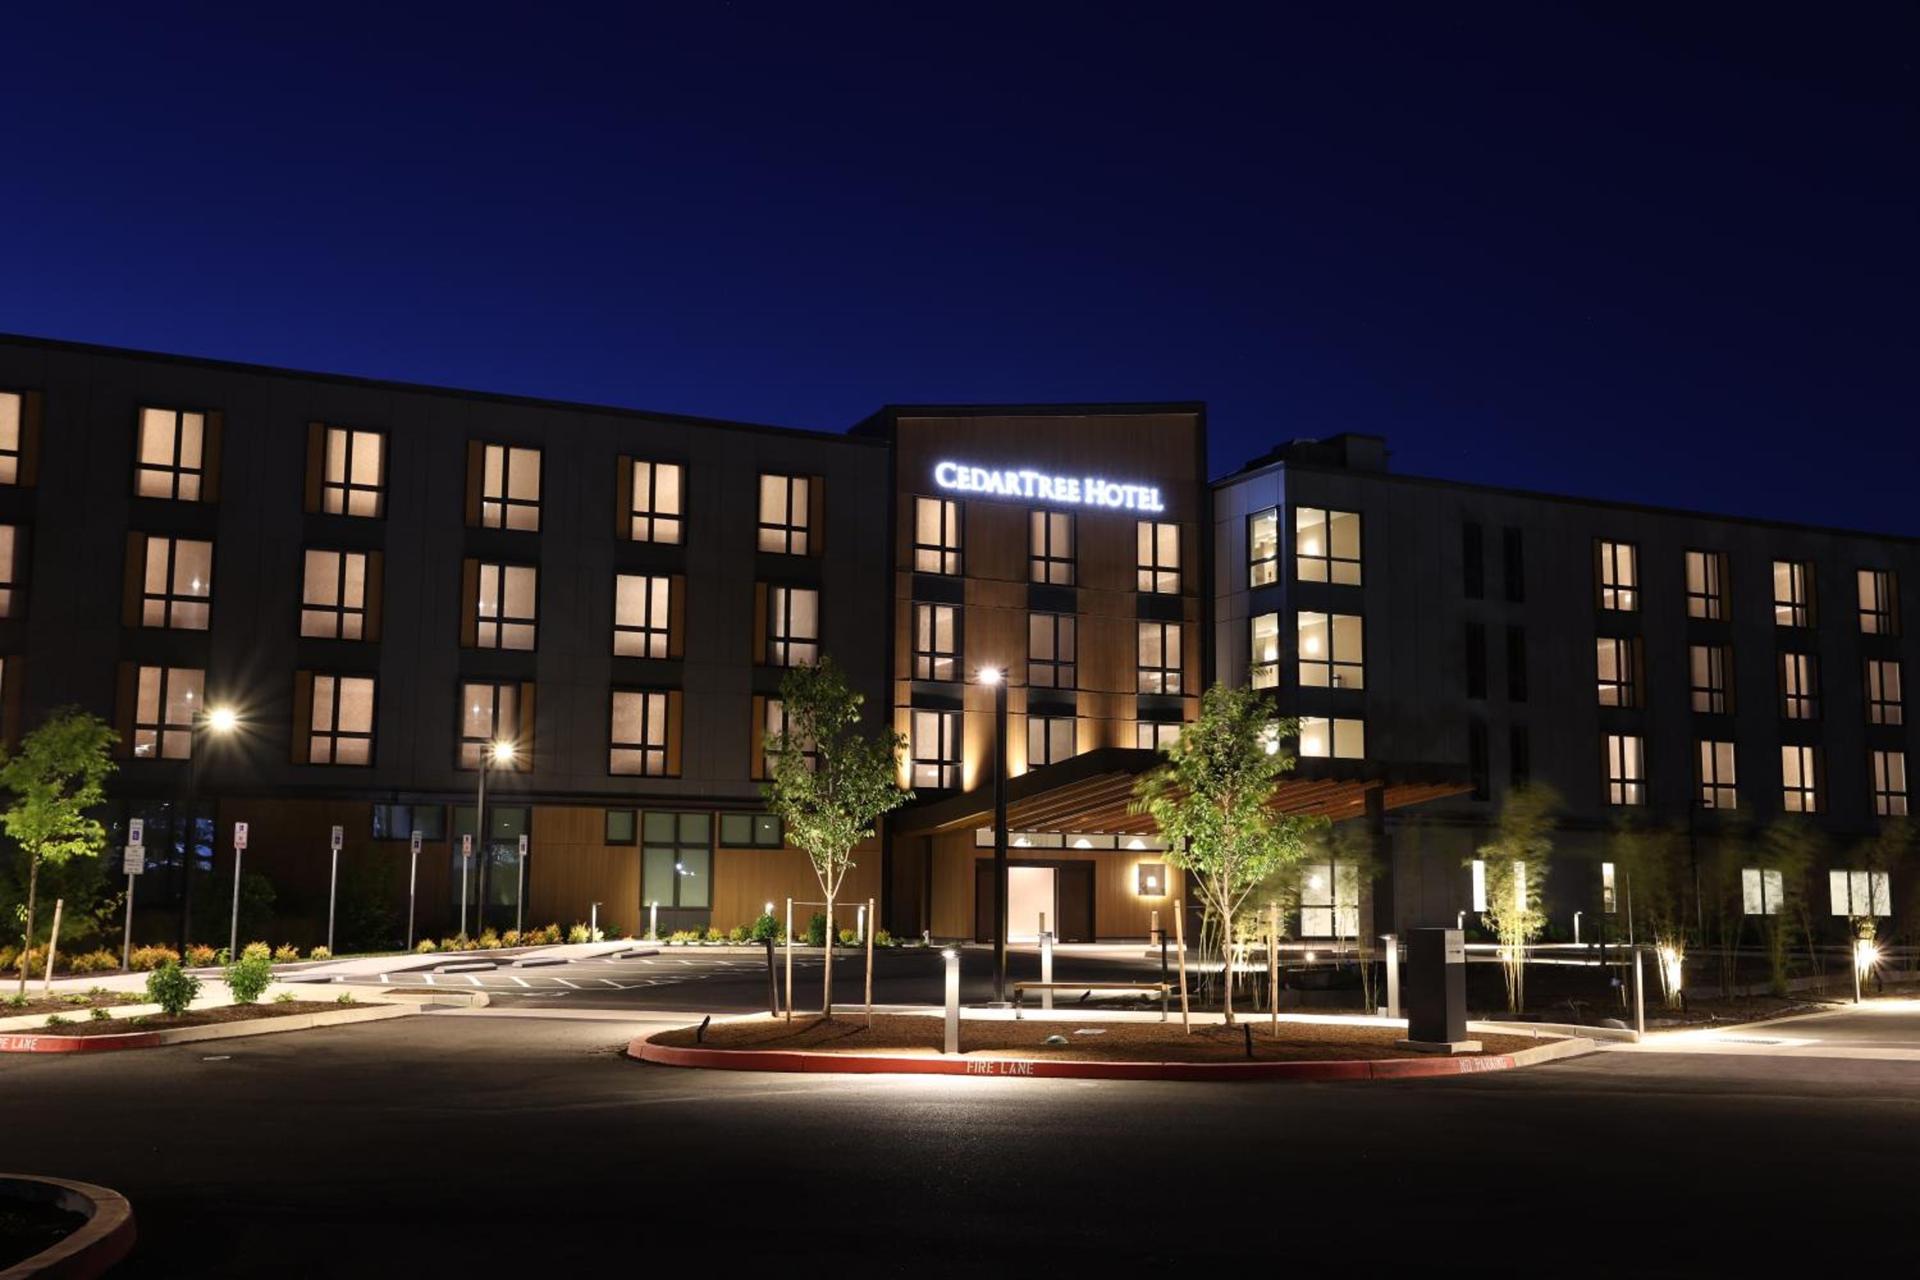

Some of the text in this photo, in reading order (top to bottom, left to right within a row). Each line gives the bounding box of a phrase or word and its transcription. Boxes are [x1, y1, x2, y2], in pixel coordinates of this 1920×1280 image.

[935, 462, 1165, 511] CEDARTREE HOTEL
[11, 1038, 37, 1050] LANE
[966, 1060, 1034, 1075] FIRE LANE
